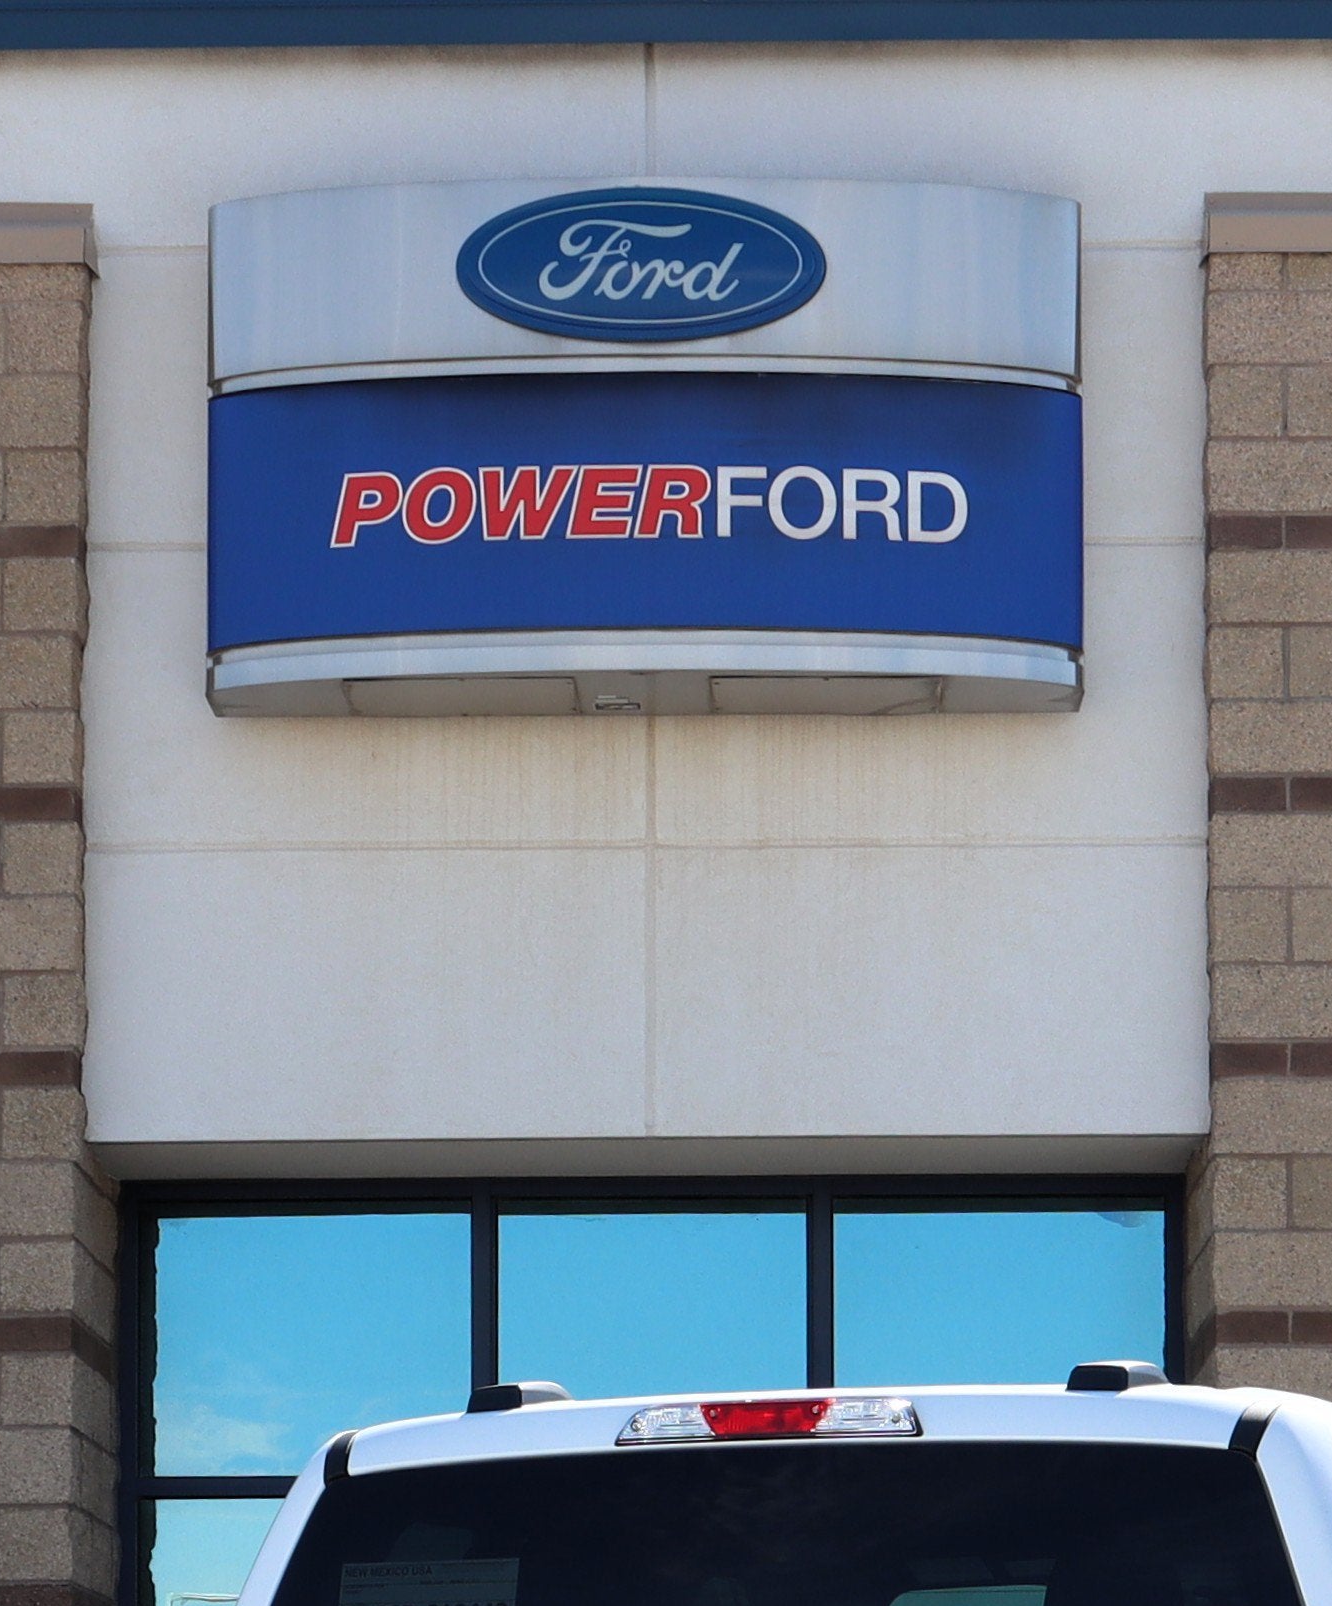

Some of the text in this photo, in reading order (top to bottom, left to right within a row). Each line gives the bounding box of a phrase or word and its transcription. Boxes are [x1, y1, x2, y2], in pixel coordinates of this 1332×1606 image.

[539, 218, 745, 303] Ford
[329, 463, 970, 549] POWERFORD
[370, 1567, 409, 1578] MEXICO
[411, 1565, 433, 1576] USA
